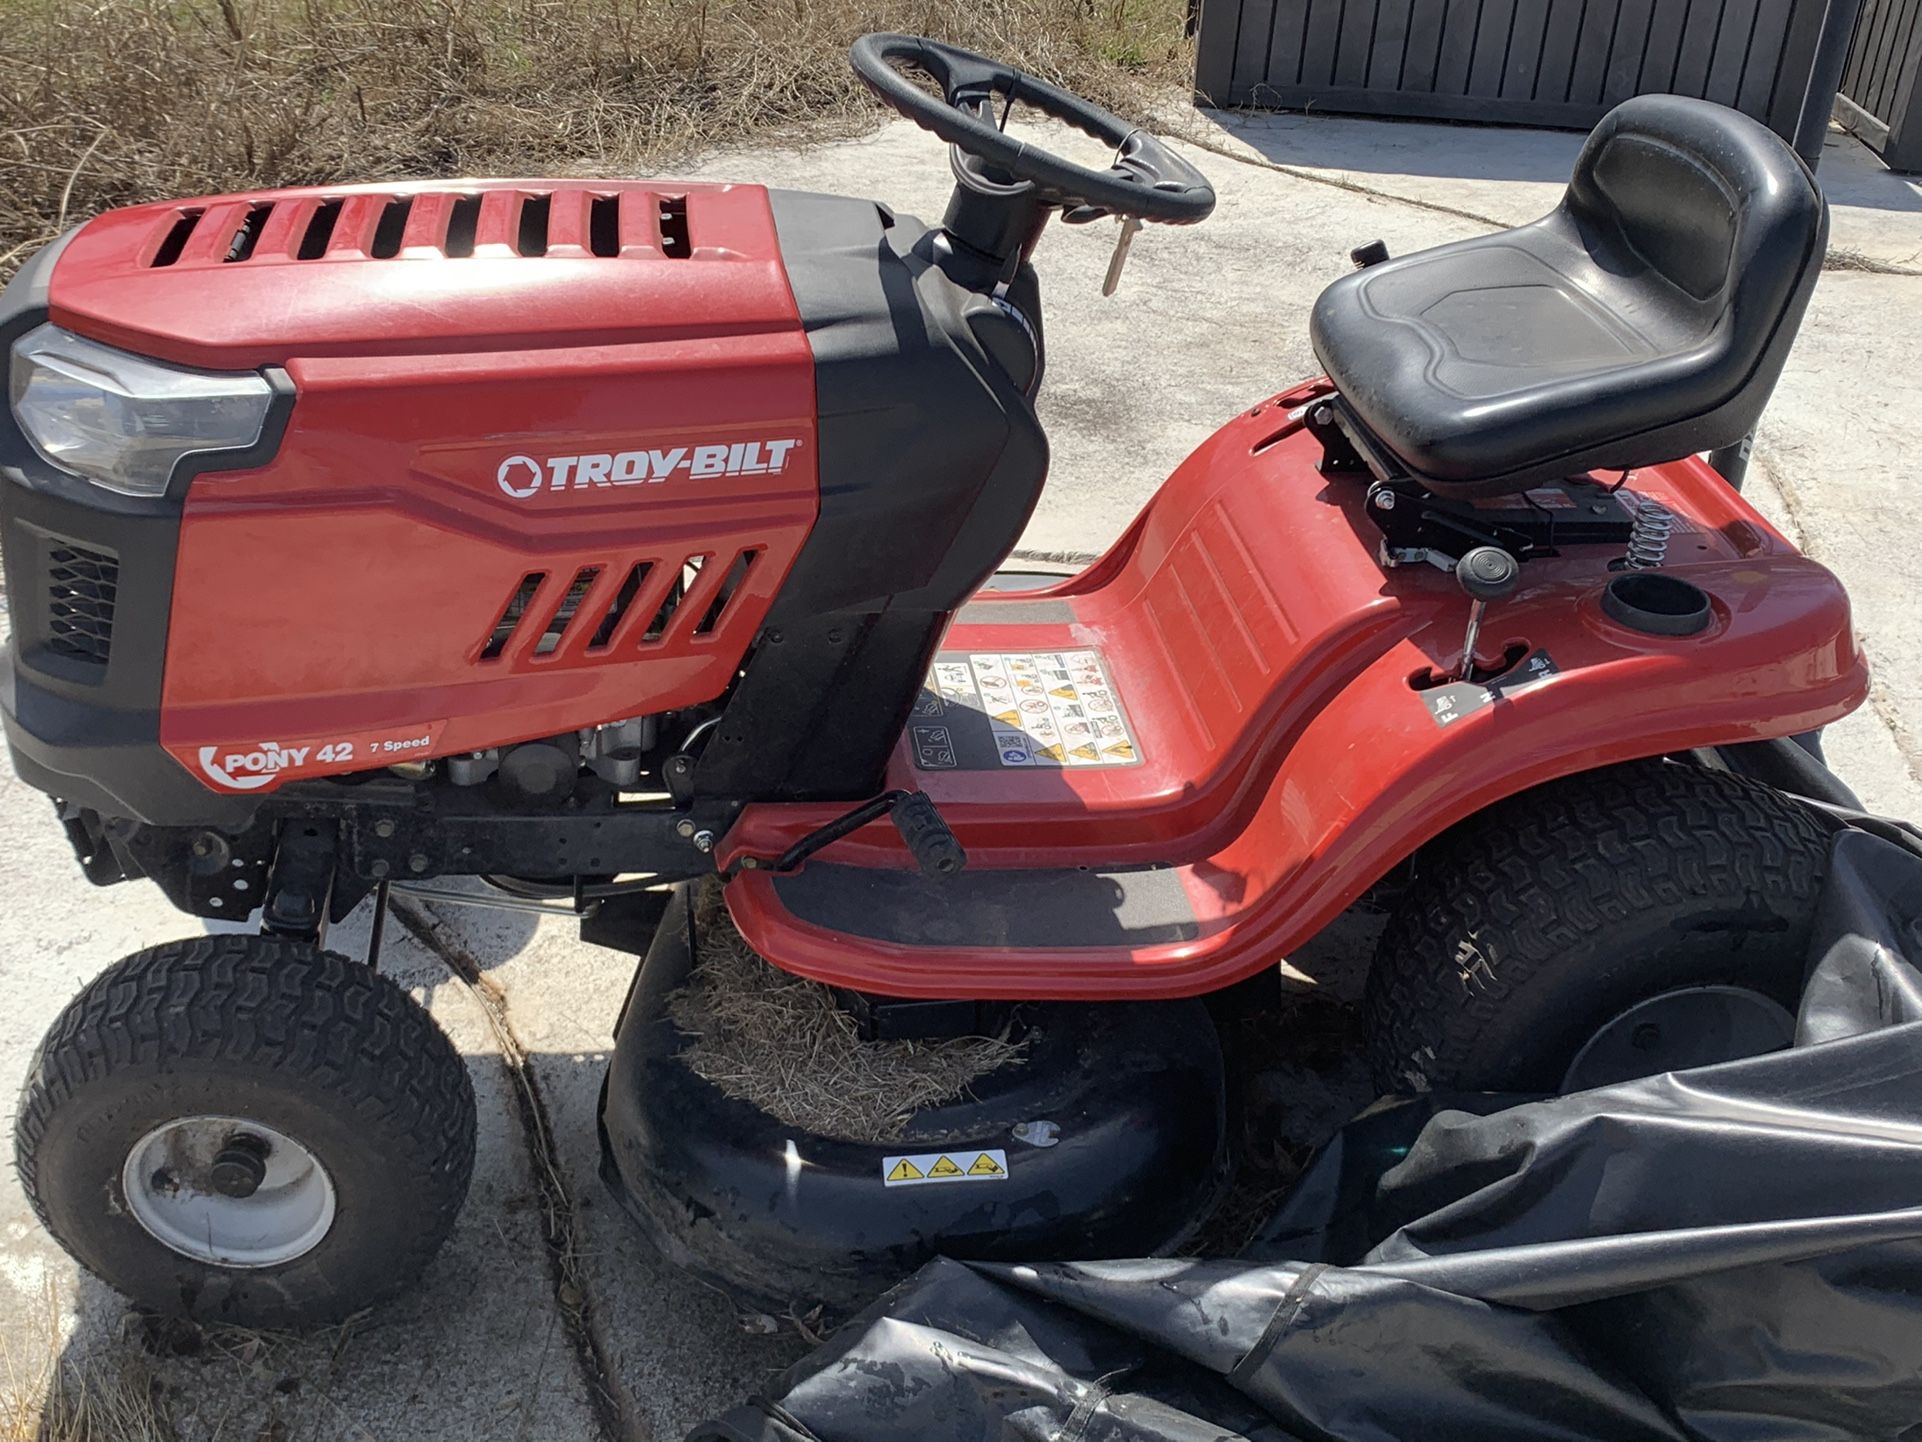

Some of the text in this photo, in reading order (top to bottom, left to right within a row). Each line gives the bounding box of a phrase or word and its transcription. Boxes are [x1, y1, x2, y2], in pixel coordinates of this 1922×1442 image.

[225, 735, 429, 773] PONY 42 7 Speed
